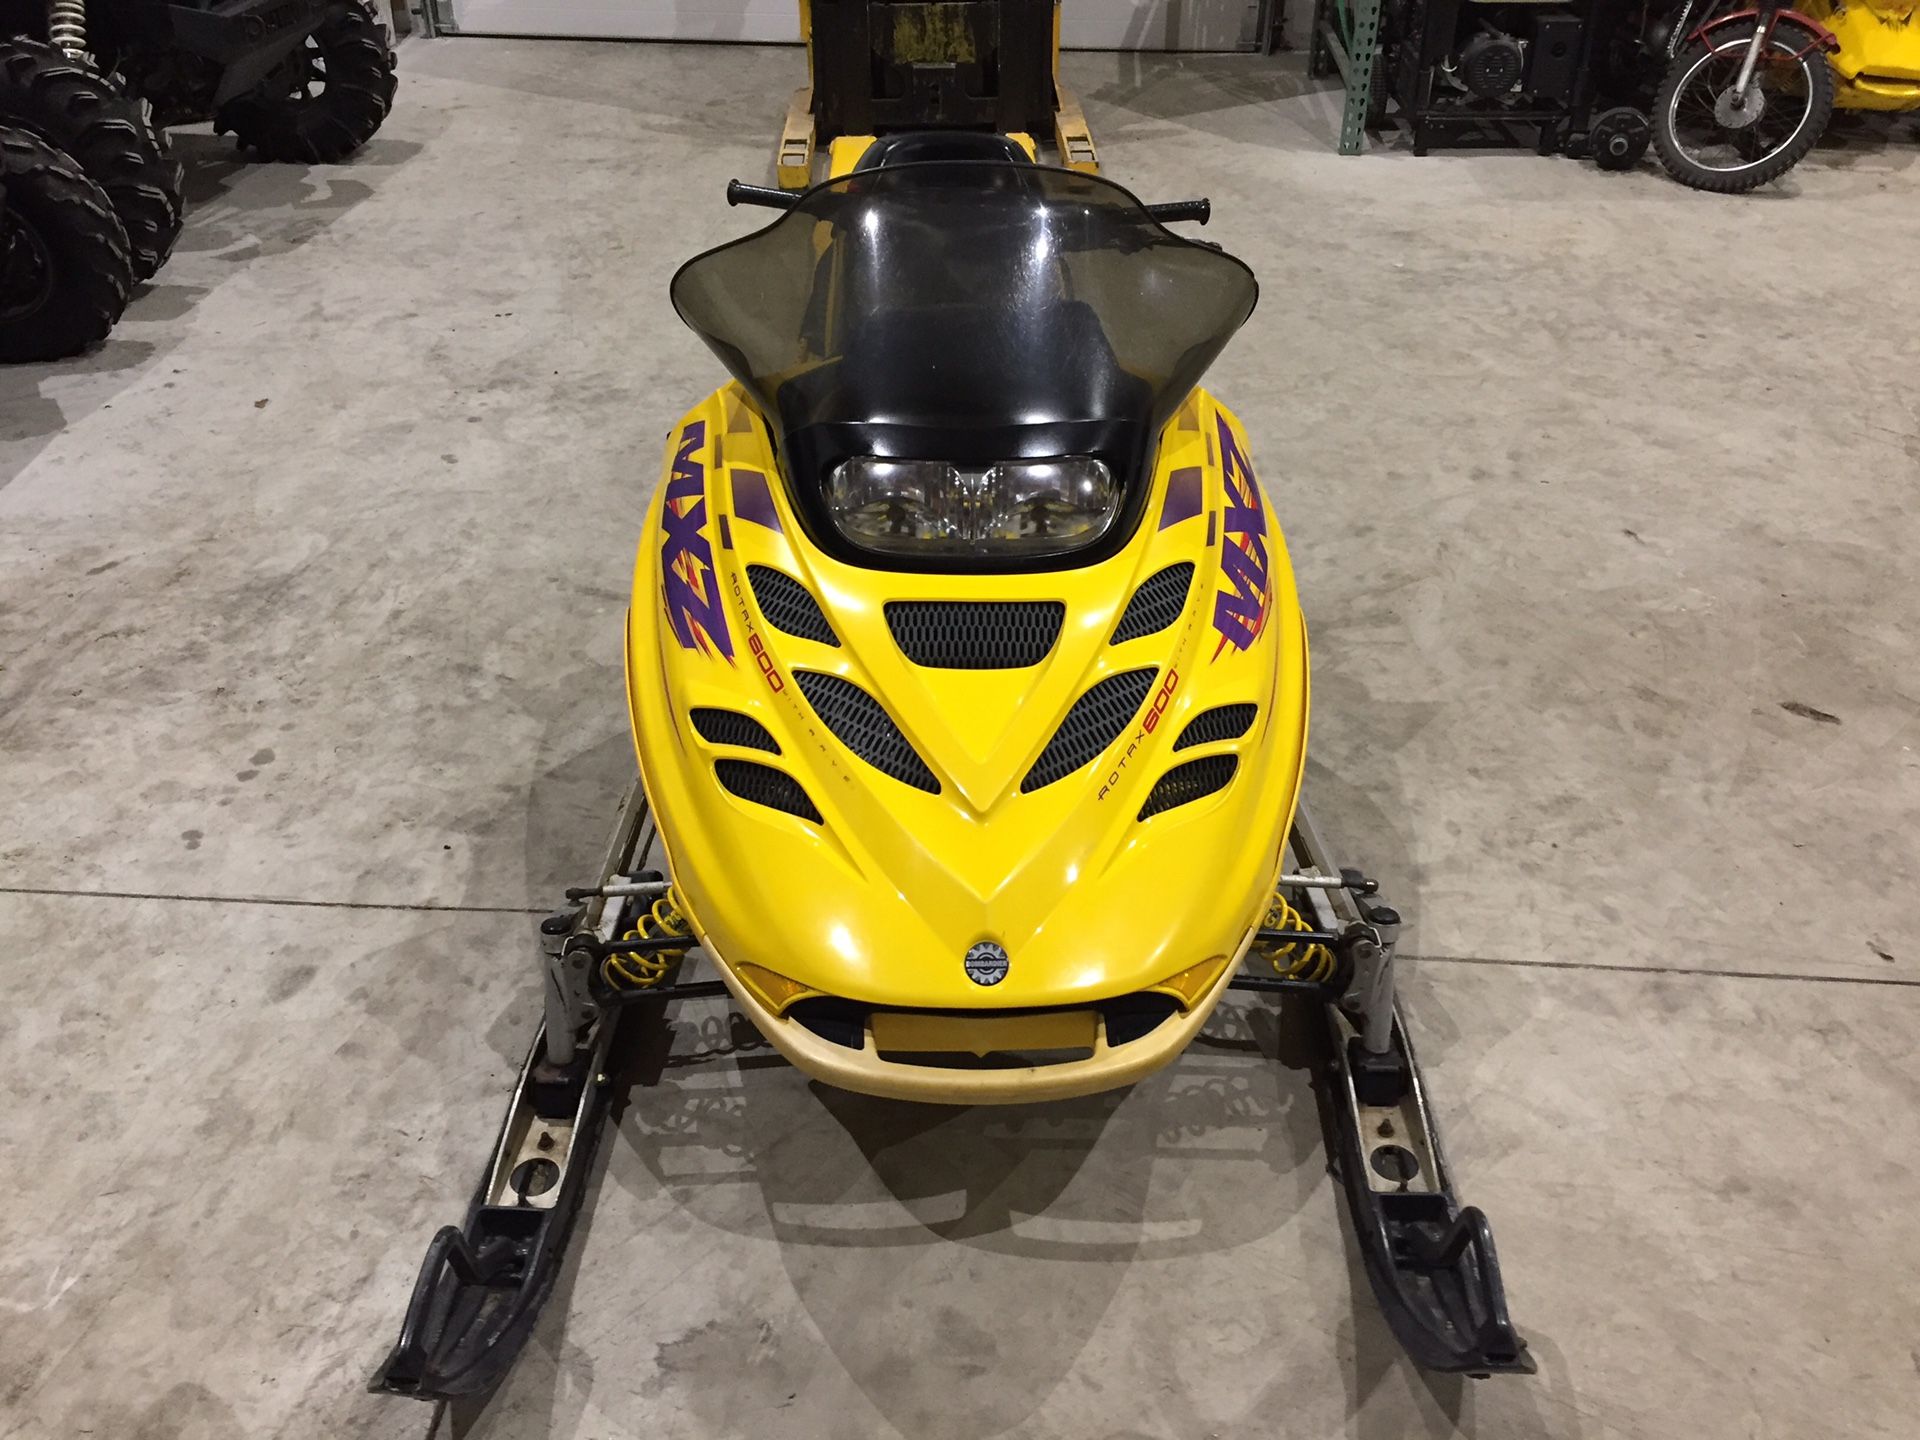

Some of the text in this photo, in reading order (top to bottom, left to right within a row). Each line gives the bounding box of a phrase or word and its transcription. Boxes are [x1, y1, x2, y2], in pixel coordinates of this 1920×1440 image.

[661, 420, 735, 662] MXZ
[731, 572, 754, 633] ROTAX
[1211, 409, 1270, 655] MXZ
[1098, 730, 1145, 801] ROTAX
[1143, 668, 1179, 735] 600
